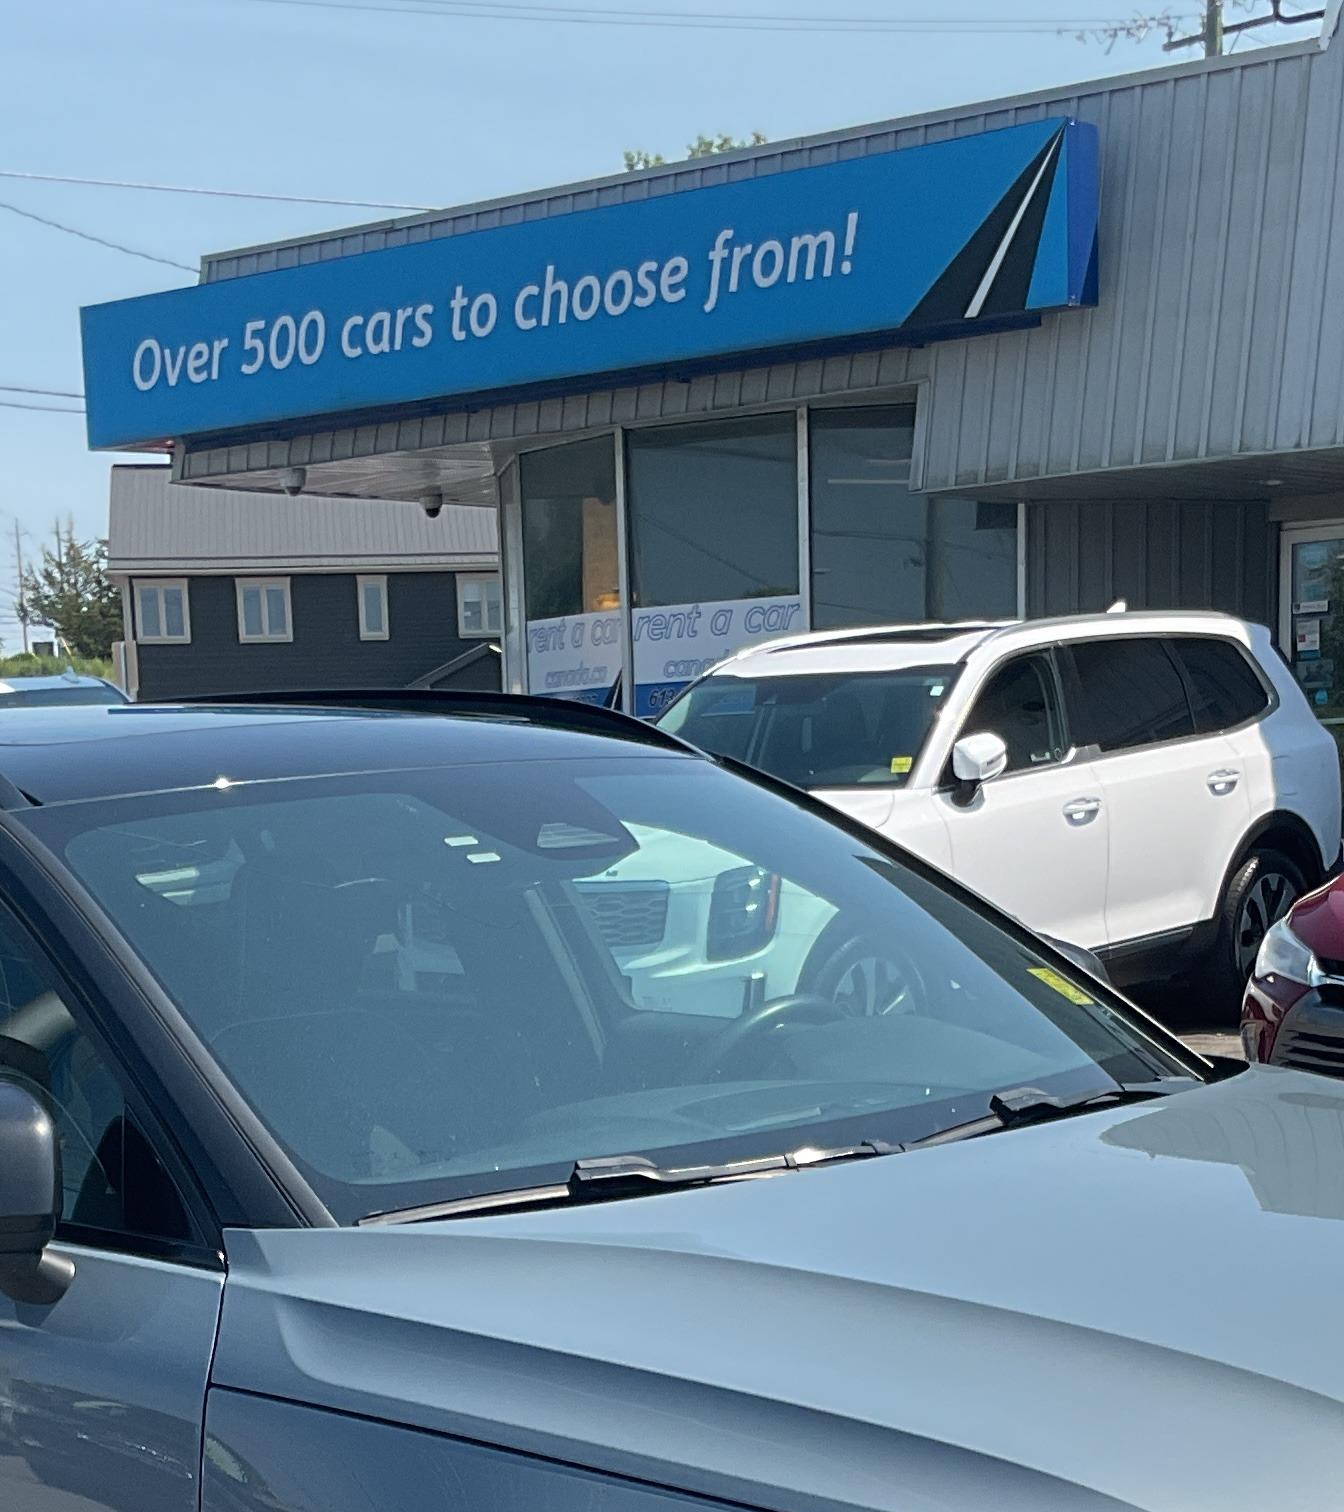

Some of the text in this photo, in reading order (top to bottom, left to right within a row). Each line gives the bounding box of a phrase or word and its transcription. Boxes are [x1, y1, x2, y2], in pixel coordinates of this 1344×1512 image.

[133, 212, 859, 391] Over 500 cars to choose from!
[634, 603, 800, 641] rent a car
